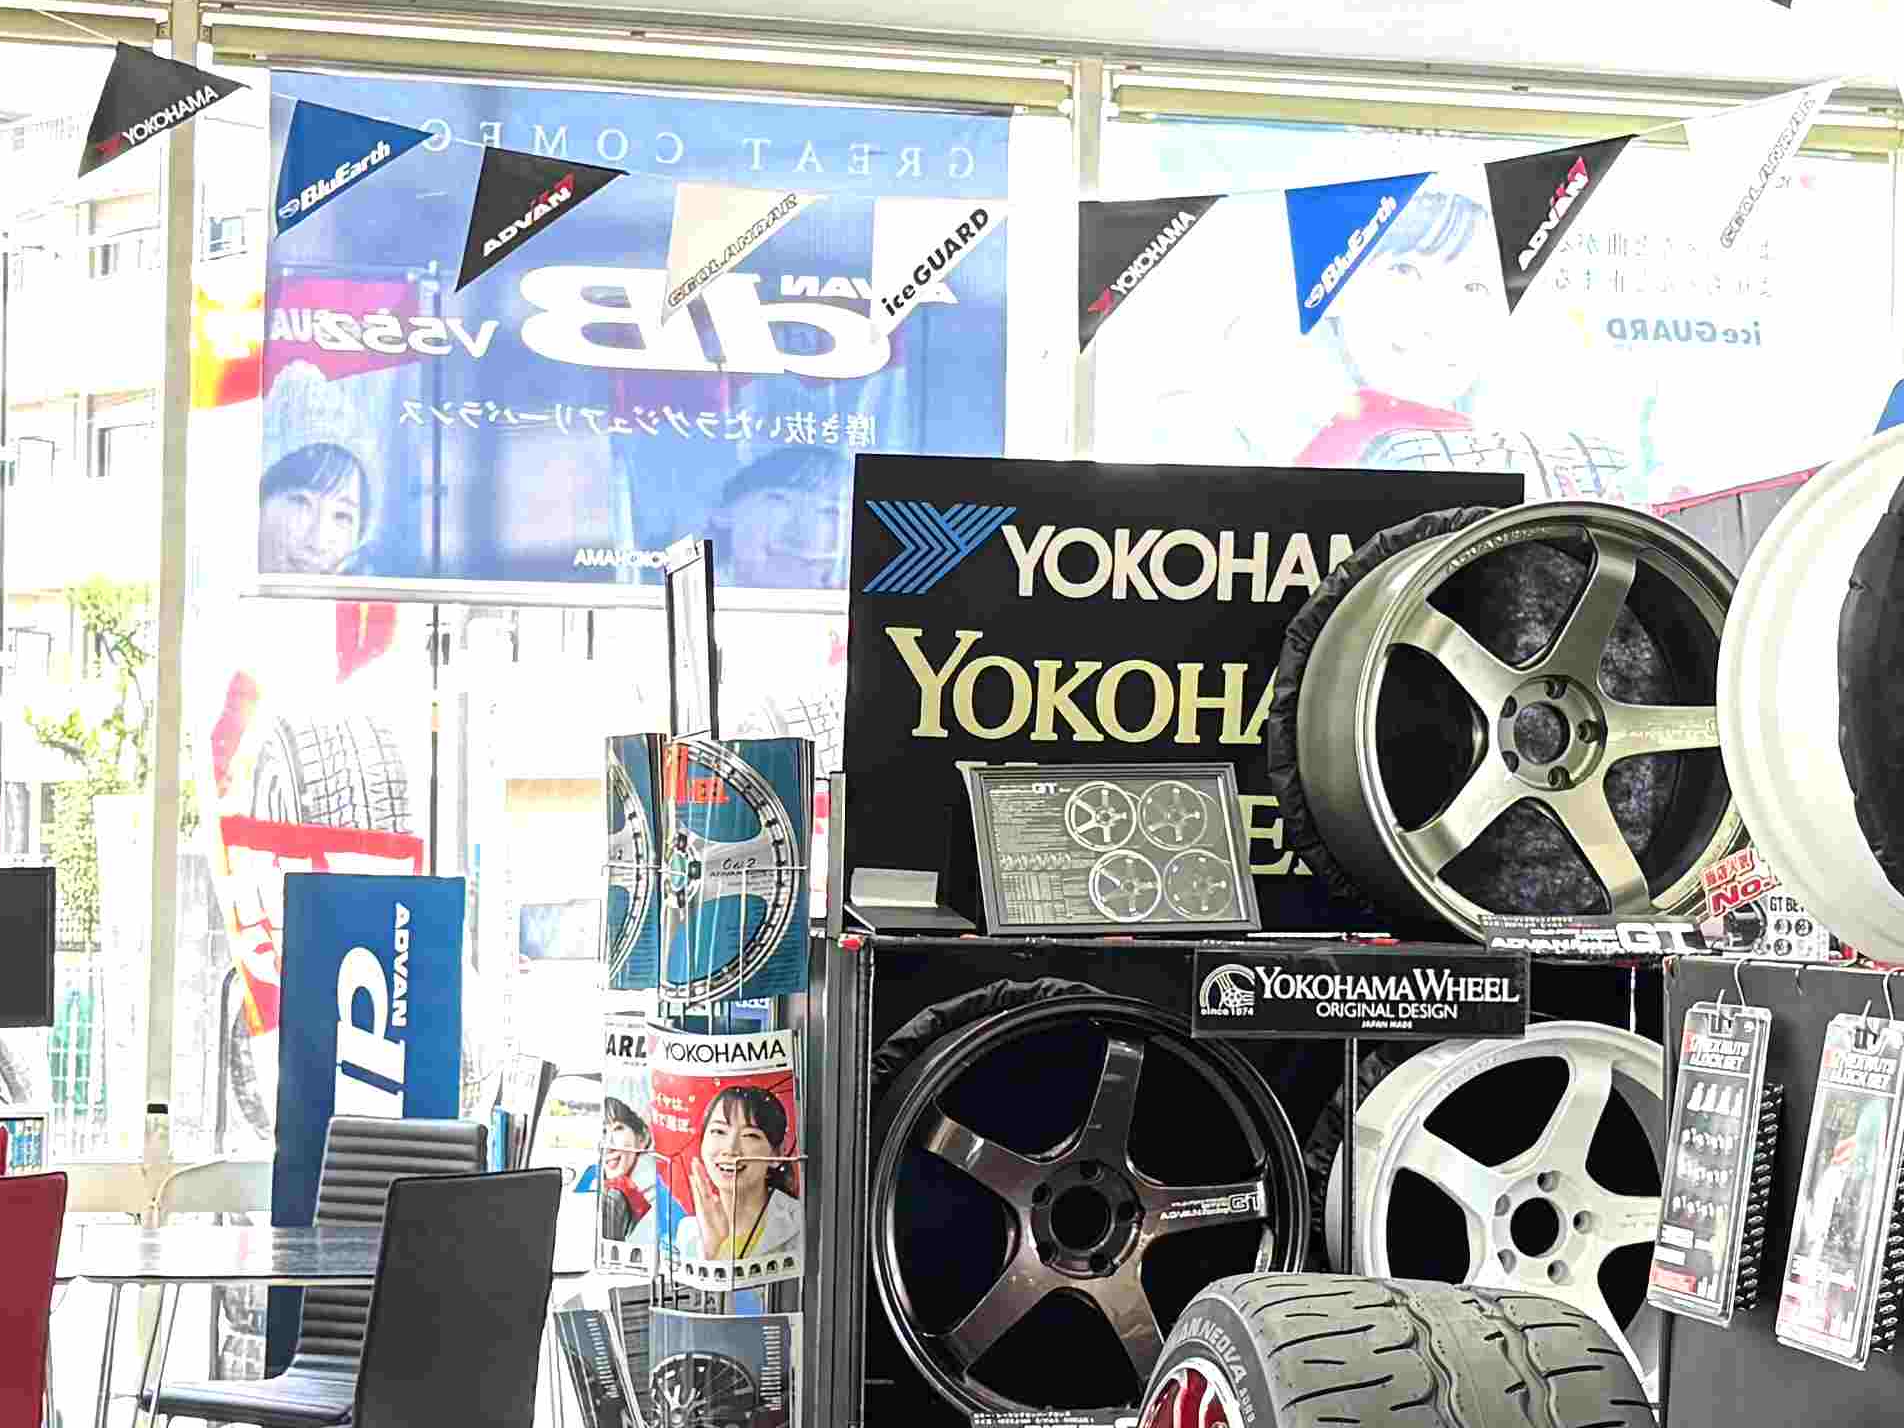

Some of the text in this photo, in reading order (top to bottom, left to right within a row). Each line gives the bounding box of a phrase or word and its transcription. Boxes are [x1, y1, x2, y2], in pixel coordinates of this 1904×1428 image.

[121, 84, 219, 145] YOKOHAMA
[298, 139, 392, 212] BluEarth
[482, 185, 573, 258] ADVAN
[1109, 209, 1198, 298] YOKOHAMA
[1318, 193, 1398, 298] BluEarth
[1518, 171, 1591, 272] ADVAN
[880, 207, 992, 319] iceGUARD
[1001, 524, 1357, 603] YOKOHA
[885, 626, 1279, 745] YOKOH
[391, 900, 413, 1027] ADVAN
[1255, 966, 1520, 1004] YOKOHAMA WHEEL
[1315, 1003, 1458, 1021] ORIGINAL DESIGN
[661, 1040, 787, 1064] YOKOHAMA
